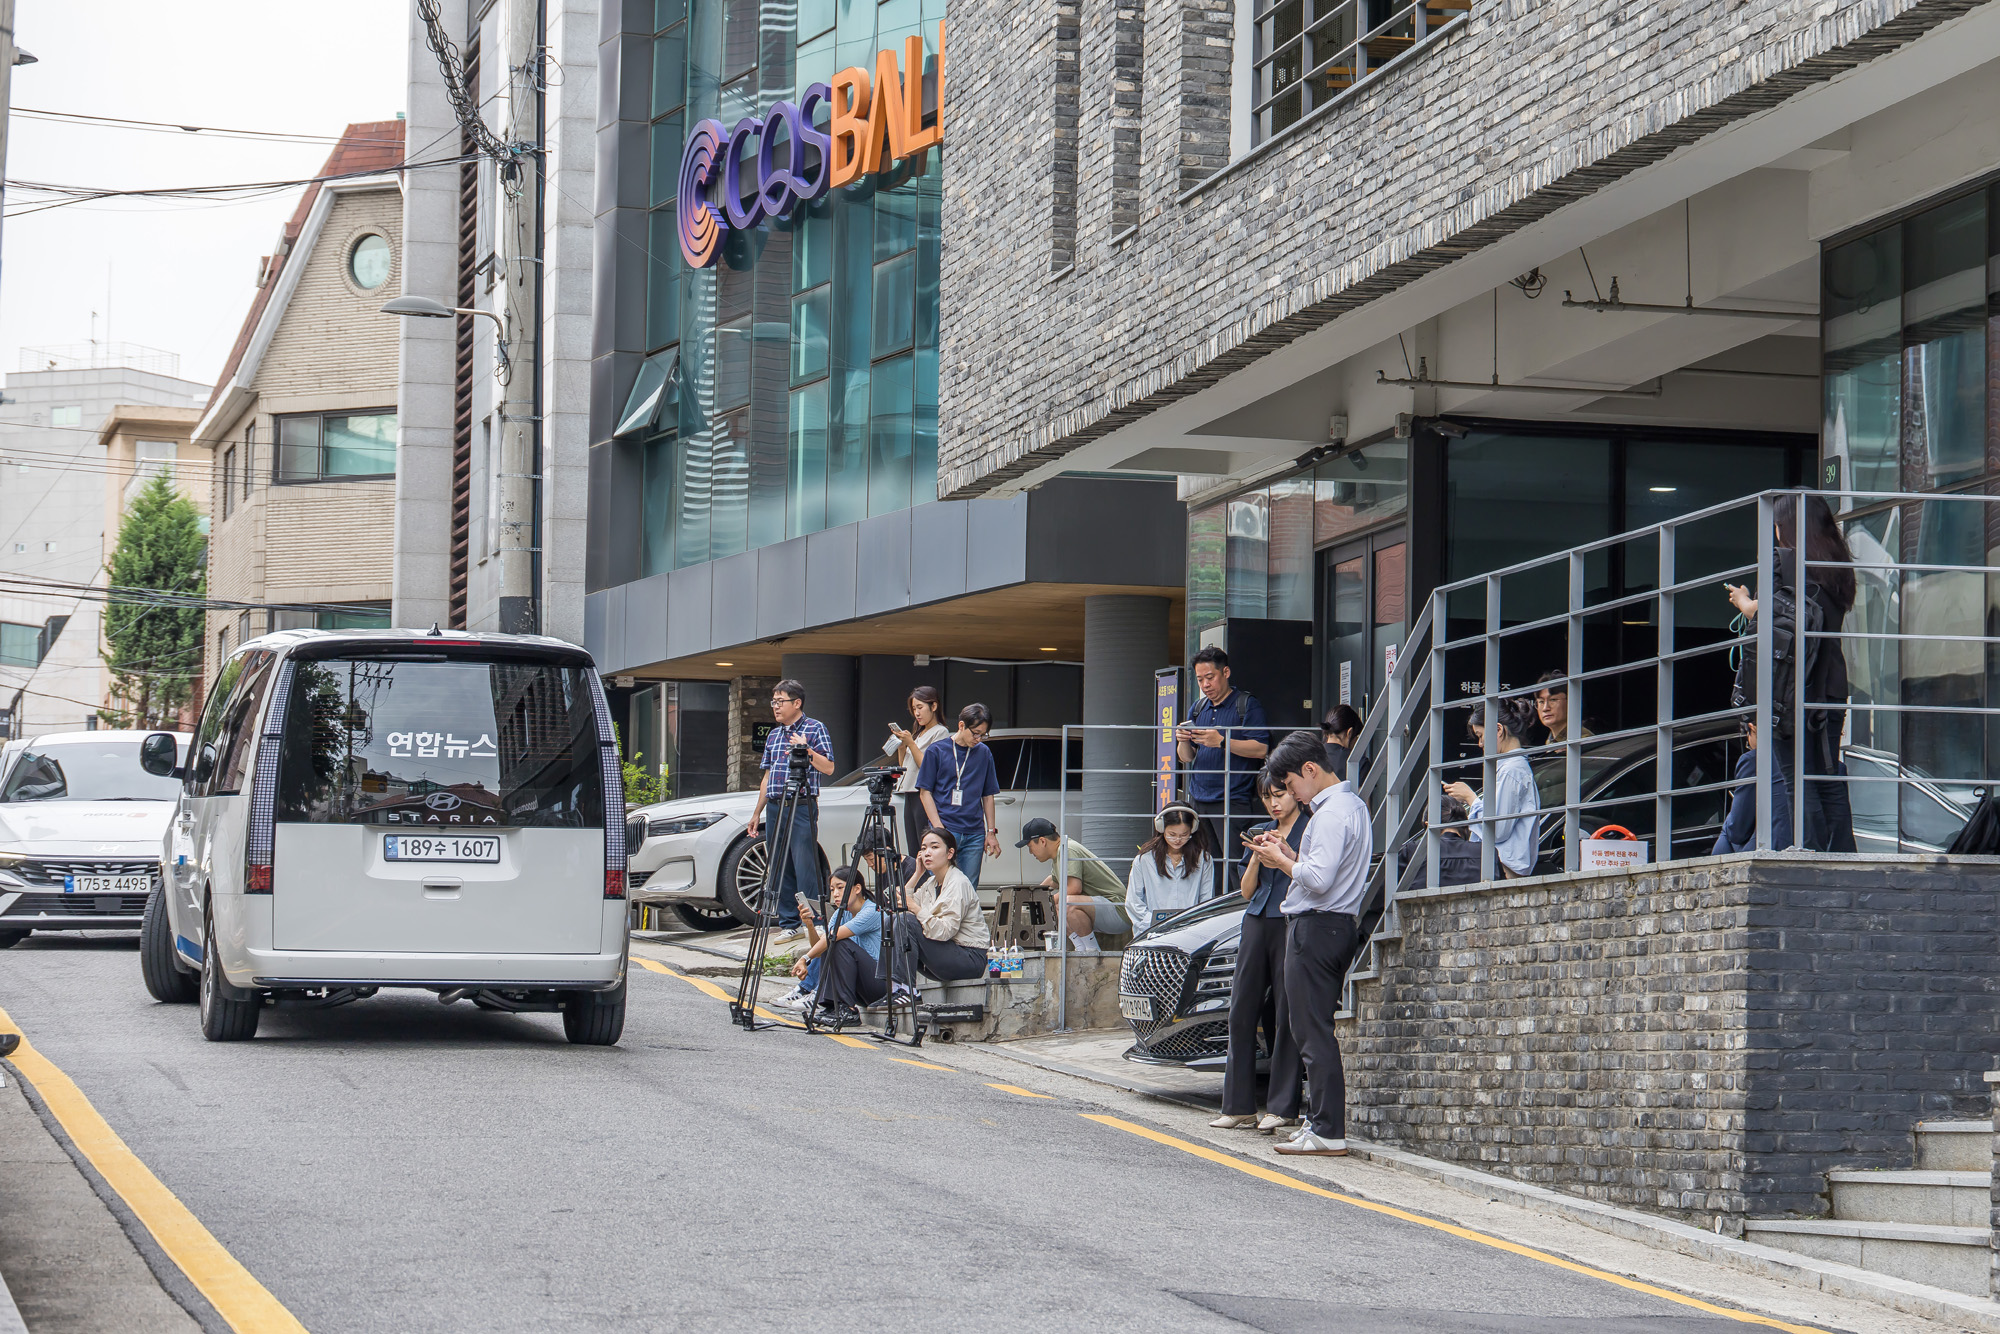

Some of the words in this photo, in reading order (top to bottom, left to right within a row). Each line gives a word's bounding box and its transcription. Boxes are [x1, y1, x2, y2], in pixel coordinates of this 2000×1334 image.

[1825, 463, 1836, 484] 39
[757, 725, 772, 737] 37
[386, 731, 497, 759] 연합뉴스
[388, 813, 496, 823] STARIA
[400, 839, 447, 857] 189수
[451, 839, 495, 858] 1607
[76, 877, 111, 891] 175호
[114, 877, 147, 891] 4495
